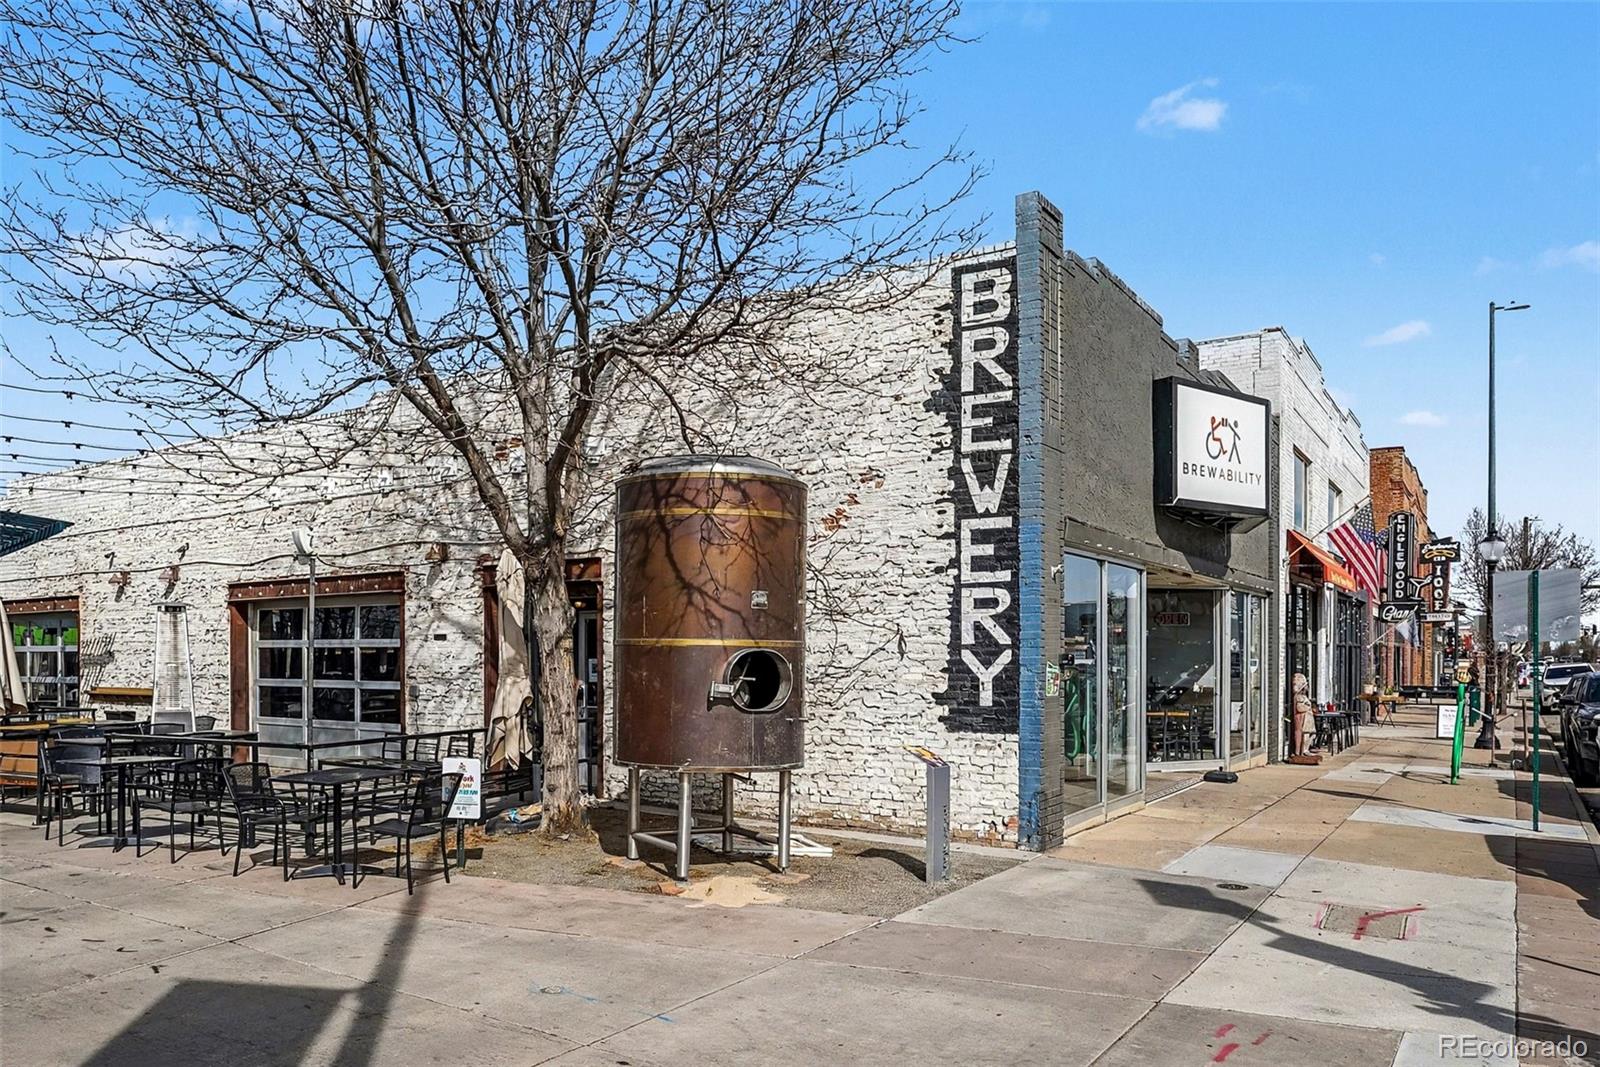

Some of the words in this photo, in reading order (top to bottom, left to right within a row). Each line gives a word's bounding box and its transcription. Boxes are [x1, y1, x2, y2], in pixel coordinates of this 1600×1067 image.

[960, 267, 1014, 707] BREWERY
[1182, 461, 1263, 486] BREWABILITY
[1394, 514, 1406, 599] ENGLEWOOD
